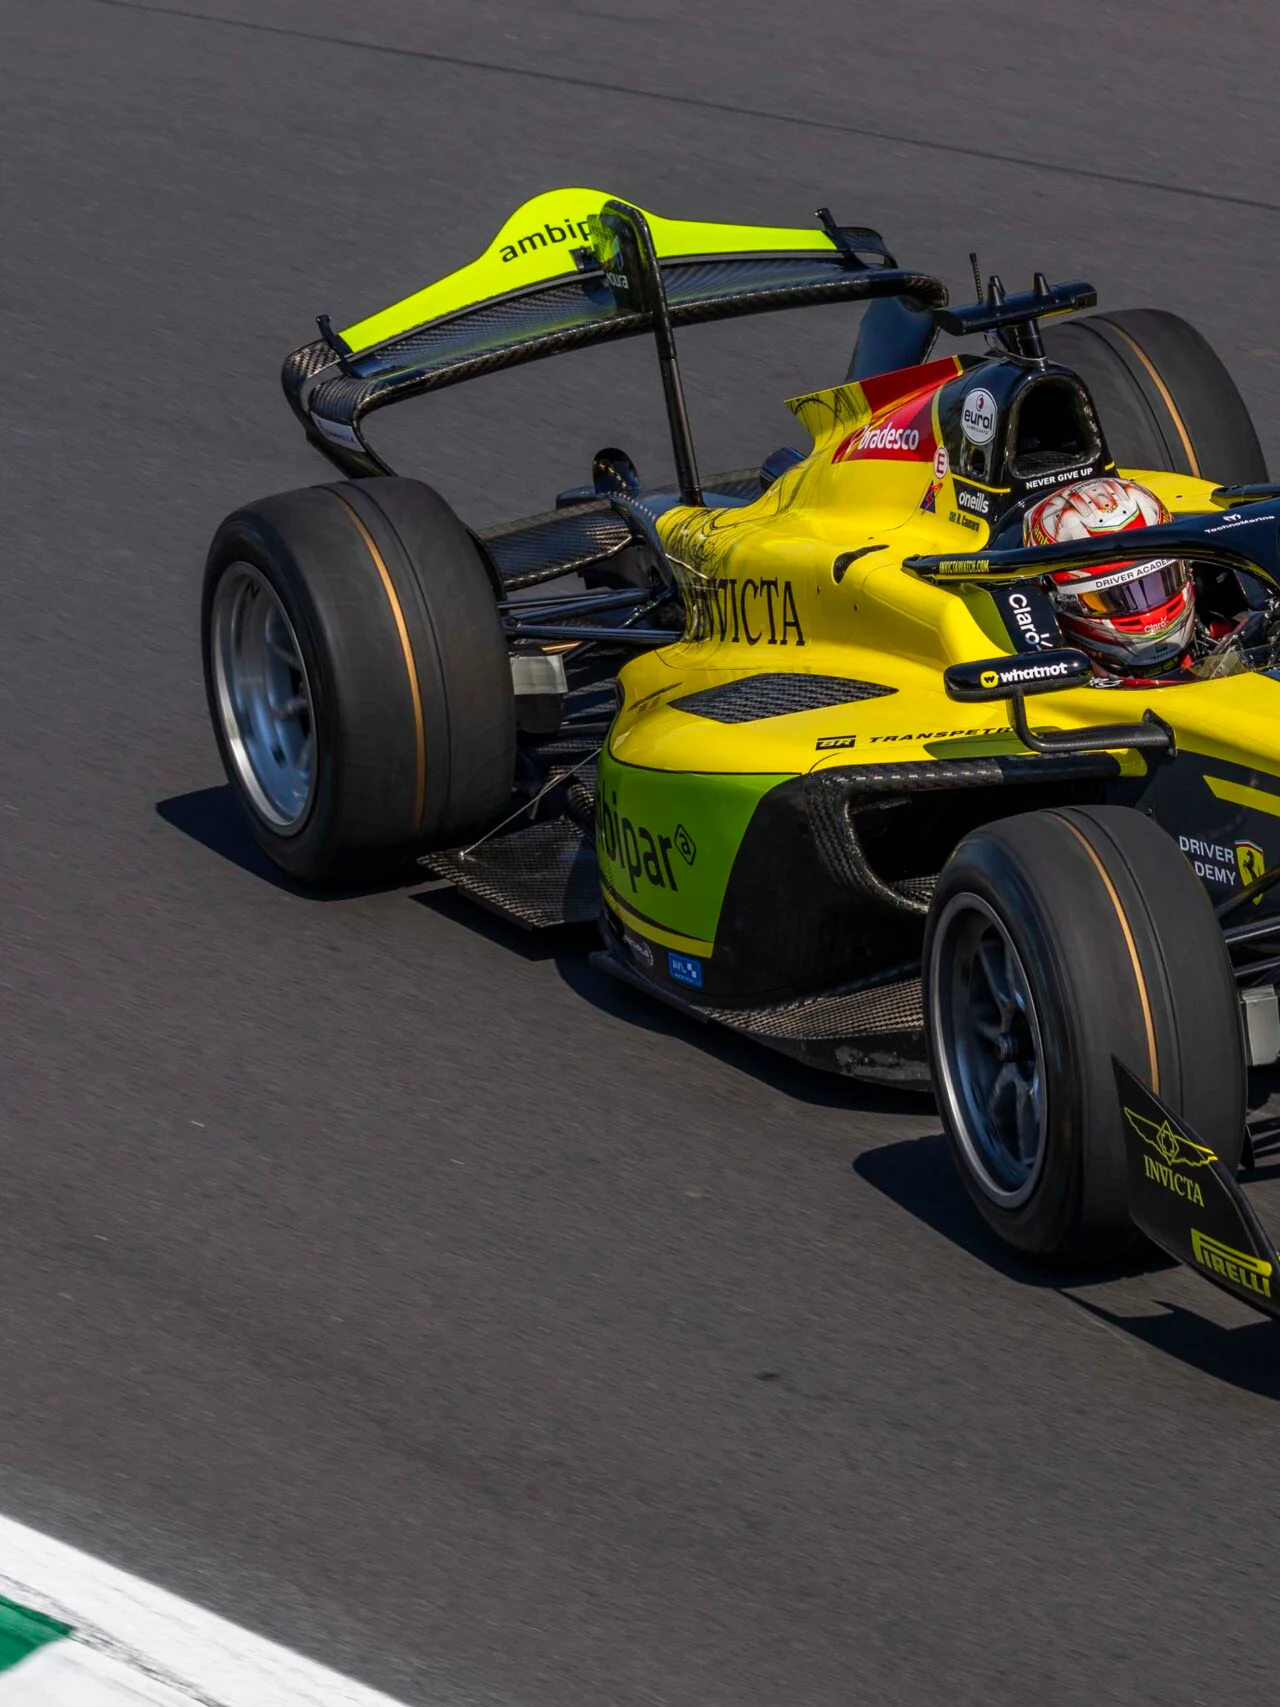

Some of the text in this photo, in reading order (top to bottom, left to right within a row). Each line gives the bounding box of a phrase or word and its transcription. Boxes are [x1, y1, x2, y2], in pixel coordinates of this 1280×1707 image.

[500, 218, 592, 263] ambip
[964, 409, 993, 430] eurol
[857, 422, 919, 449] bradesco
[1025, 467, 1093, 489] NEVER GIVE UP
[1095, 559, 1173, 588] DRIVER ACADE
[1000, 662, 1068, 683] whatnot
[870, 727, 1014, 743] TRANSPETR
[602, 780, 678, 893] bipar
[1178, 835, 1234, 865] DRIVER
[1195, 861, 1236, 886] DEMY
[1143, 1155, 1205, 1208] INVICTA
[1190, 1227, 1273, 1298] PIRELLI
